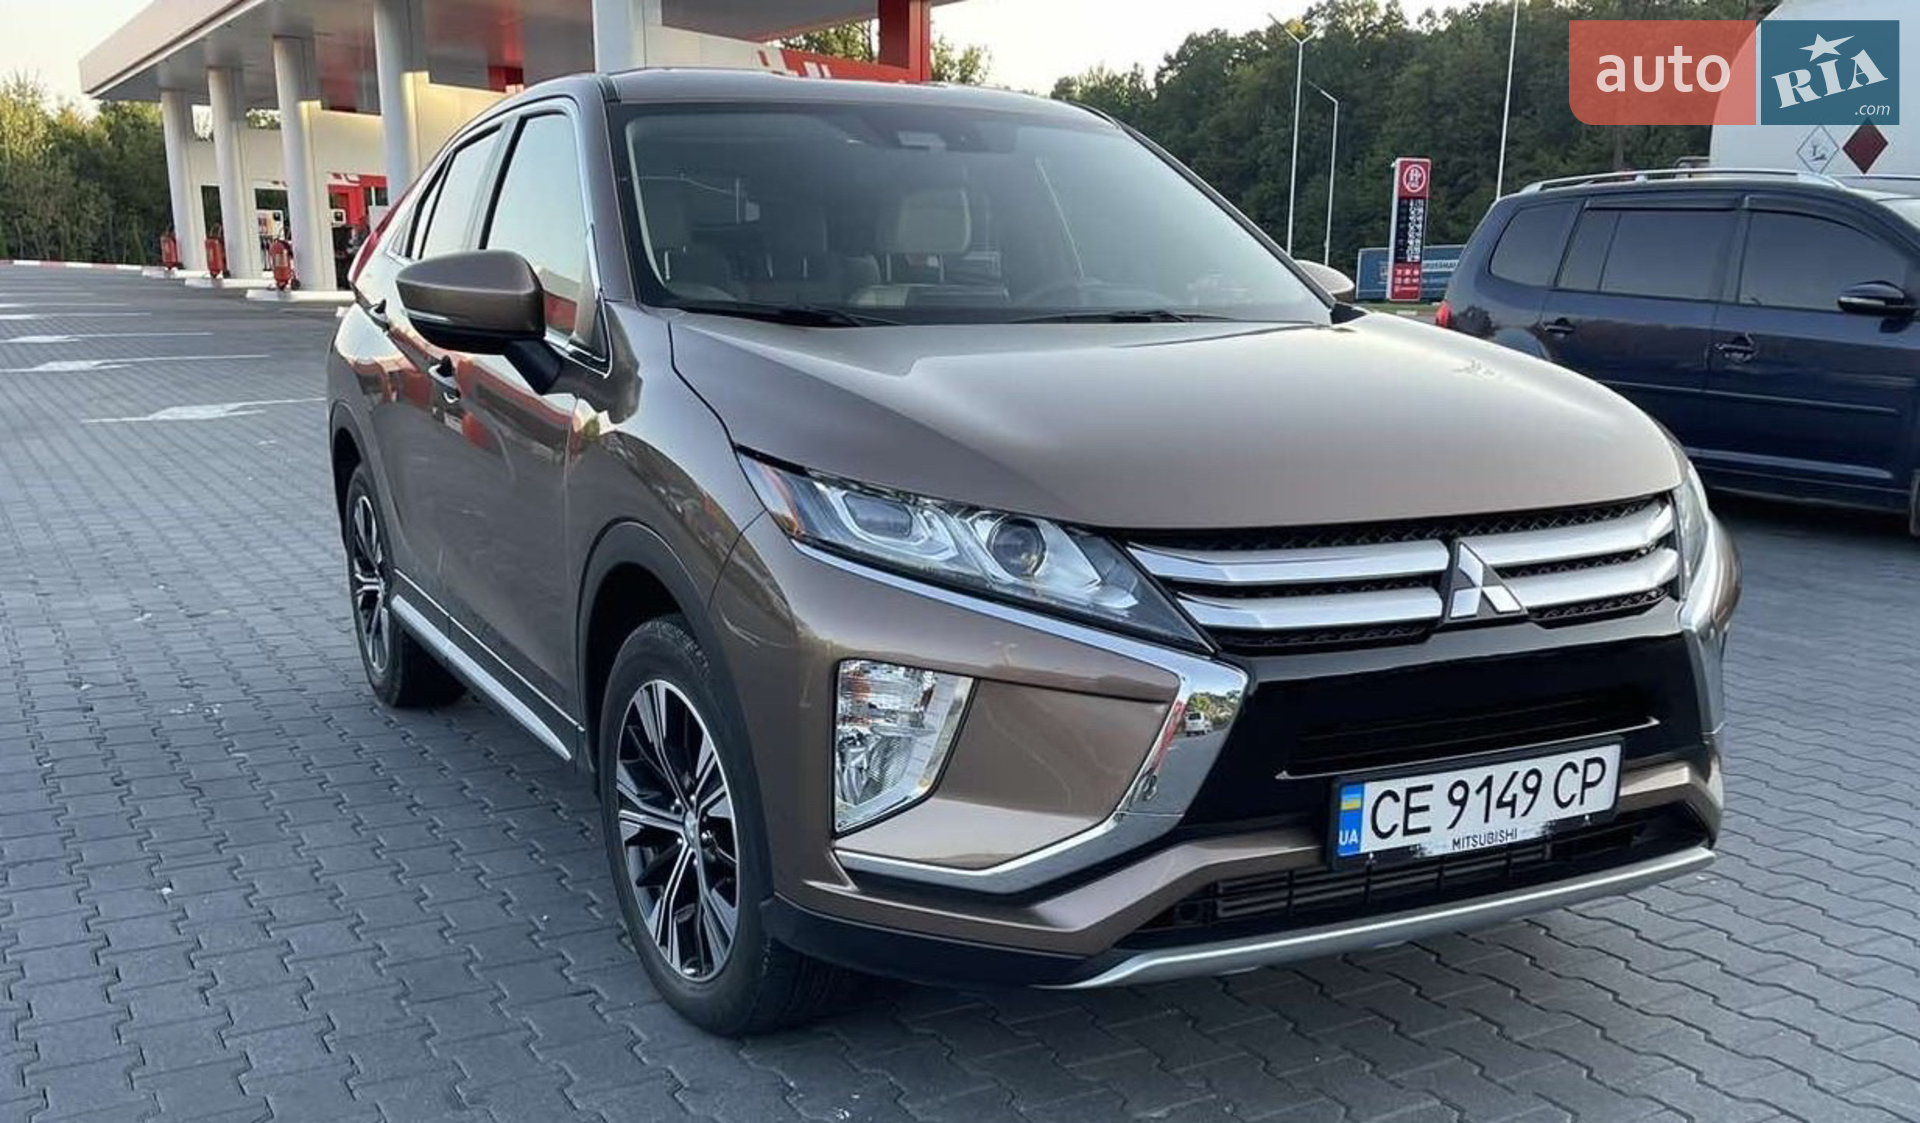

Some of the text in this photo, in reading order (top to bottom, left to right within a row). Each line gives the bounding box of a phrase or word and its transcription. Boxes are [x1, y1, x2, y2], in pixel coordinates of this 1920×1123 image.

[1371, 756, 1607, 839] CE 9149 CP
[1339, 830, 1358, 847] UA
[1452, 828, 1518, 851] MITSUBISHI
